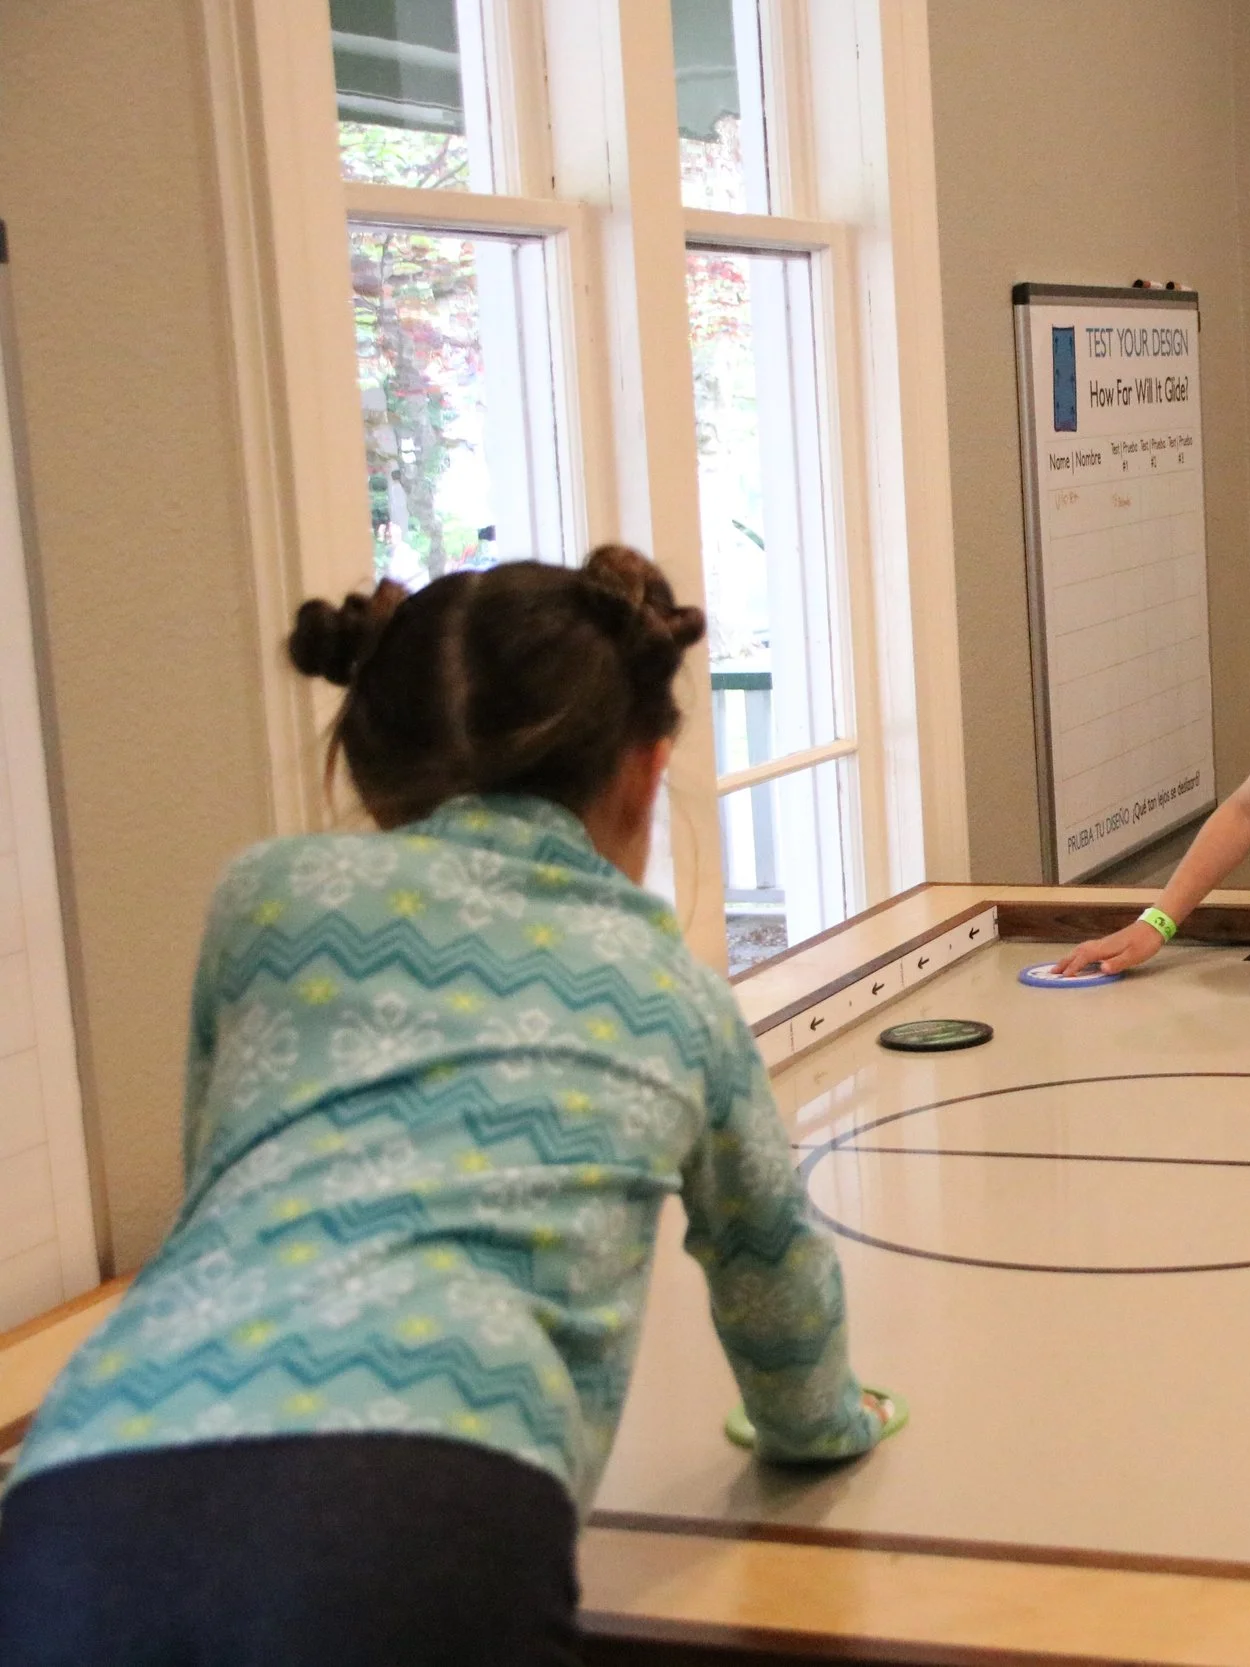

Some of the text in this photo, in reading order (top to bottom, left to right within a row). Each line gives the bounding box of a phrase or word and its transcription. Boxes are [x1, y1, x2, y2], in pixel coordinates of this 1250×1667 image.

[1085, 328, 1189, 357] TEST YOUR DESIGN
[1089, 376, 1189, 408] How Far Will It Glide?
[1049, 453, 1070, 471] Name
[1075, 448, 1102, 468] Nombre
[1067, 827, 1095, 855] PRUEBA
[1094, 820, 1105, 839] TU
